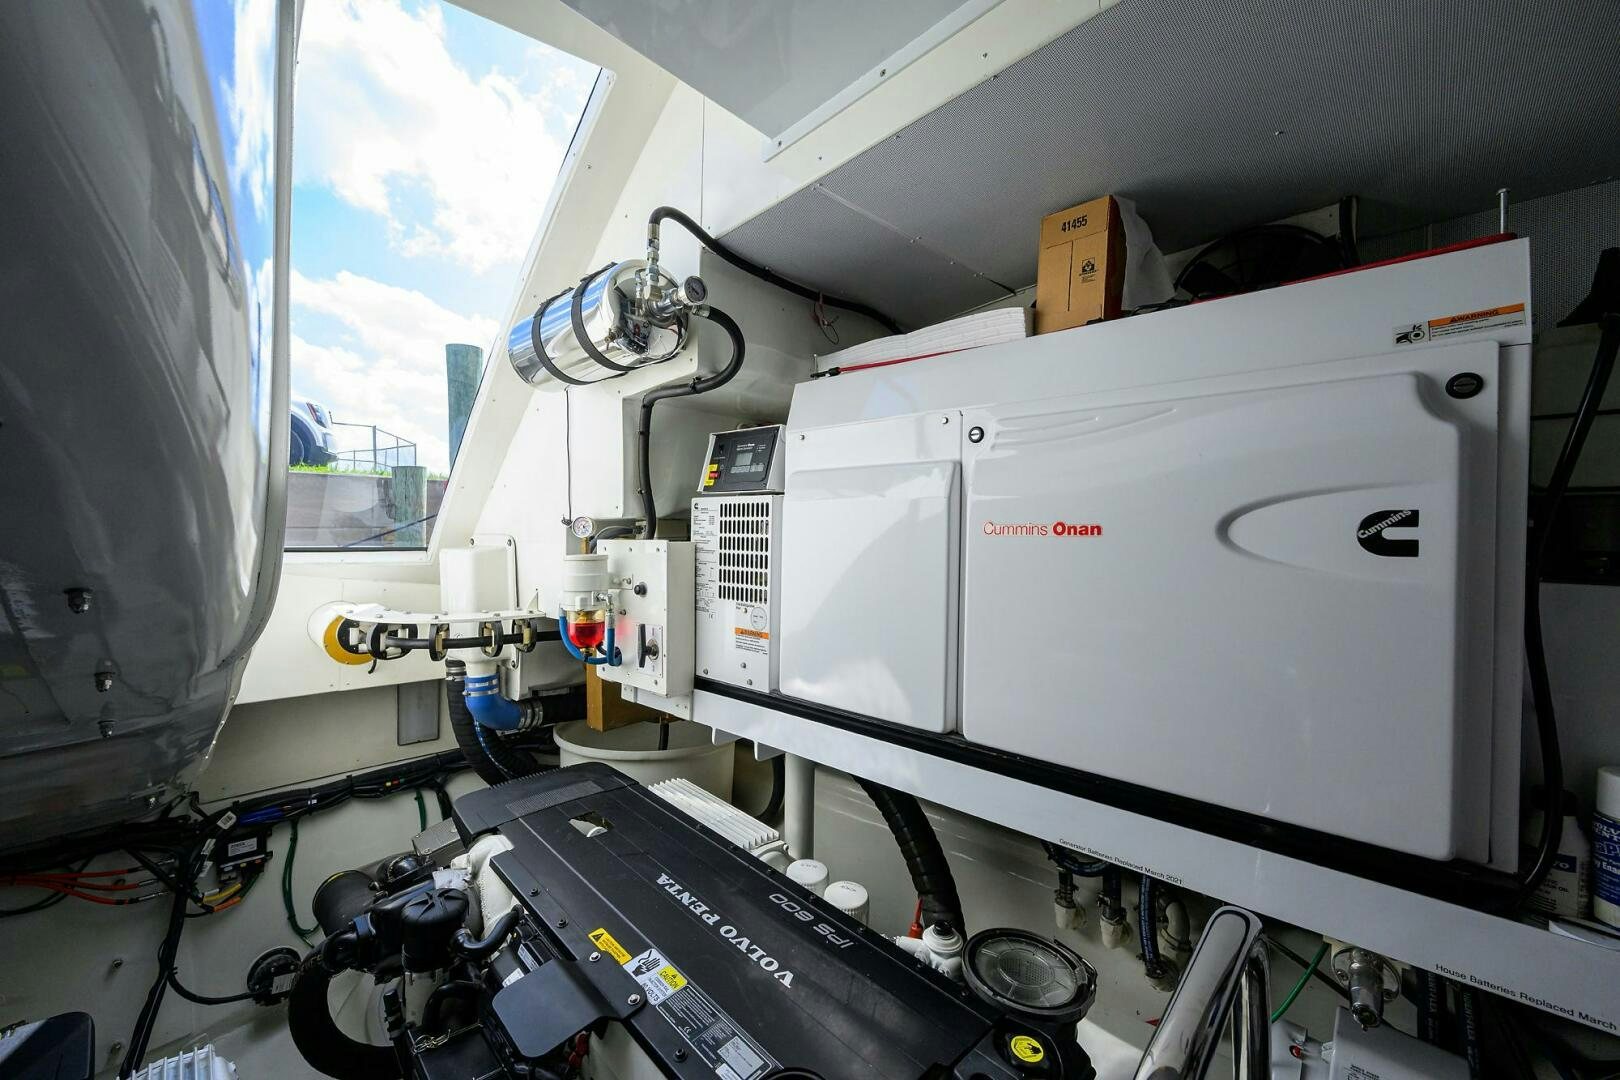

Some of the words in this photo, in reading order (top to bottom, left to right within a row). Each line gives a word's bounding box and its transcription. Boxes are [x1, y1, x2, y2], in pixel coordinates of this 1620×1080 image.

[1061, 214, 1088, 233] 41455
[1454, 309, 1499, 323] WARNING
[983, 521, 1048, 536] Cummins
[1052, 521, 1102, 536] Onan
[1358, 510, 1412, 539] Cummins
[1114, 856, 1144, 872] Replaced
[1144, 866, 1165, 879] March
[1166, 874, 1182, 885] 2021
[656, 872, 721, 926] PENTA
[768, 893, 815, 922] 600
[812, 922, 855, 949] IPS
[719, 925, 795, 989] VOLVO
[660, 970, 679, 989] CAUTION
[1435, 963, 1467, 980] House
[1470, 974, 1517, 998] Batteries
[1519, 991, 1575, 1017] Replaced
[1578, 1011, 1617, 1032] March
